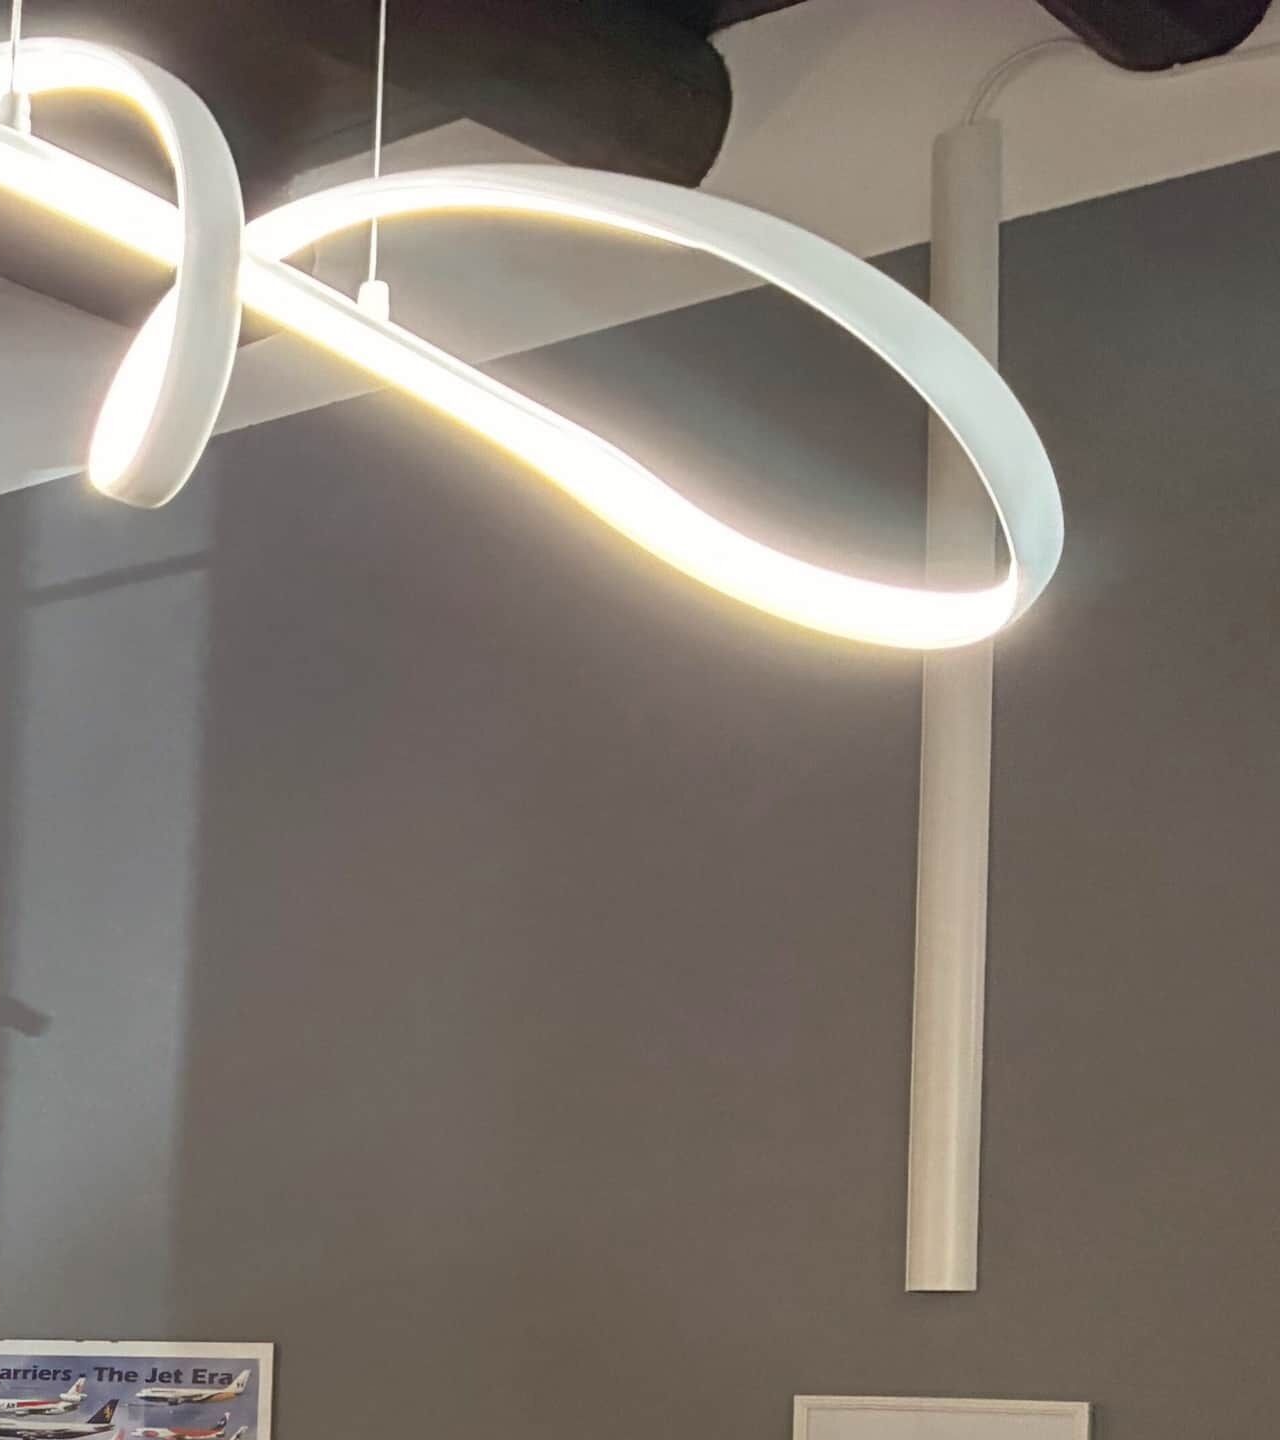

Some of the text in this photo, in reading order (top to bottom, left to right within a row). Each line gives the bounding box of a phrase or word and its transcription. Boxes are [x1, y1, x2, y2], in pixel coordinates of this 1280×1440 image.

[94, 1365, 138, 1383] The
[144, 1367, 183, 1385] Jet
[192, 1368, 234, 1387] Era
